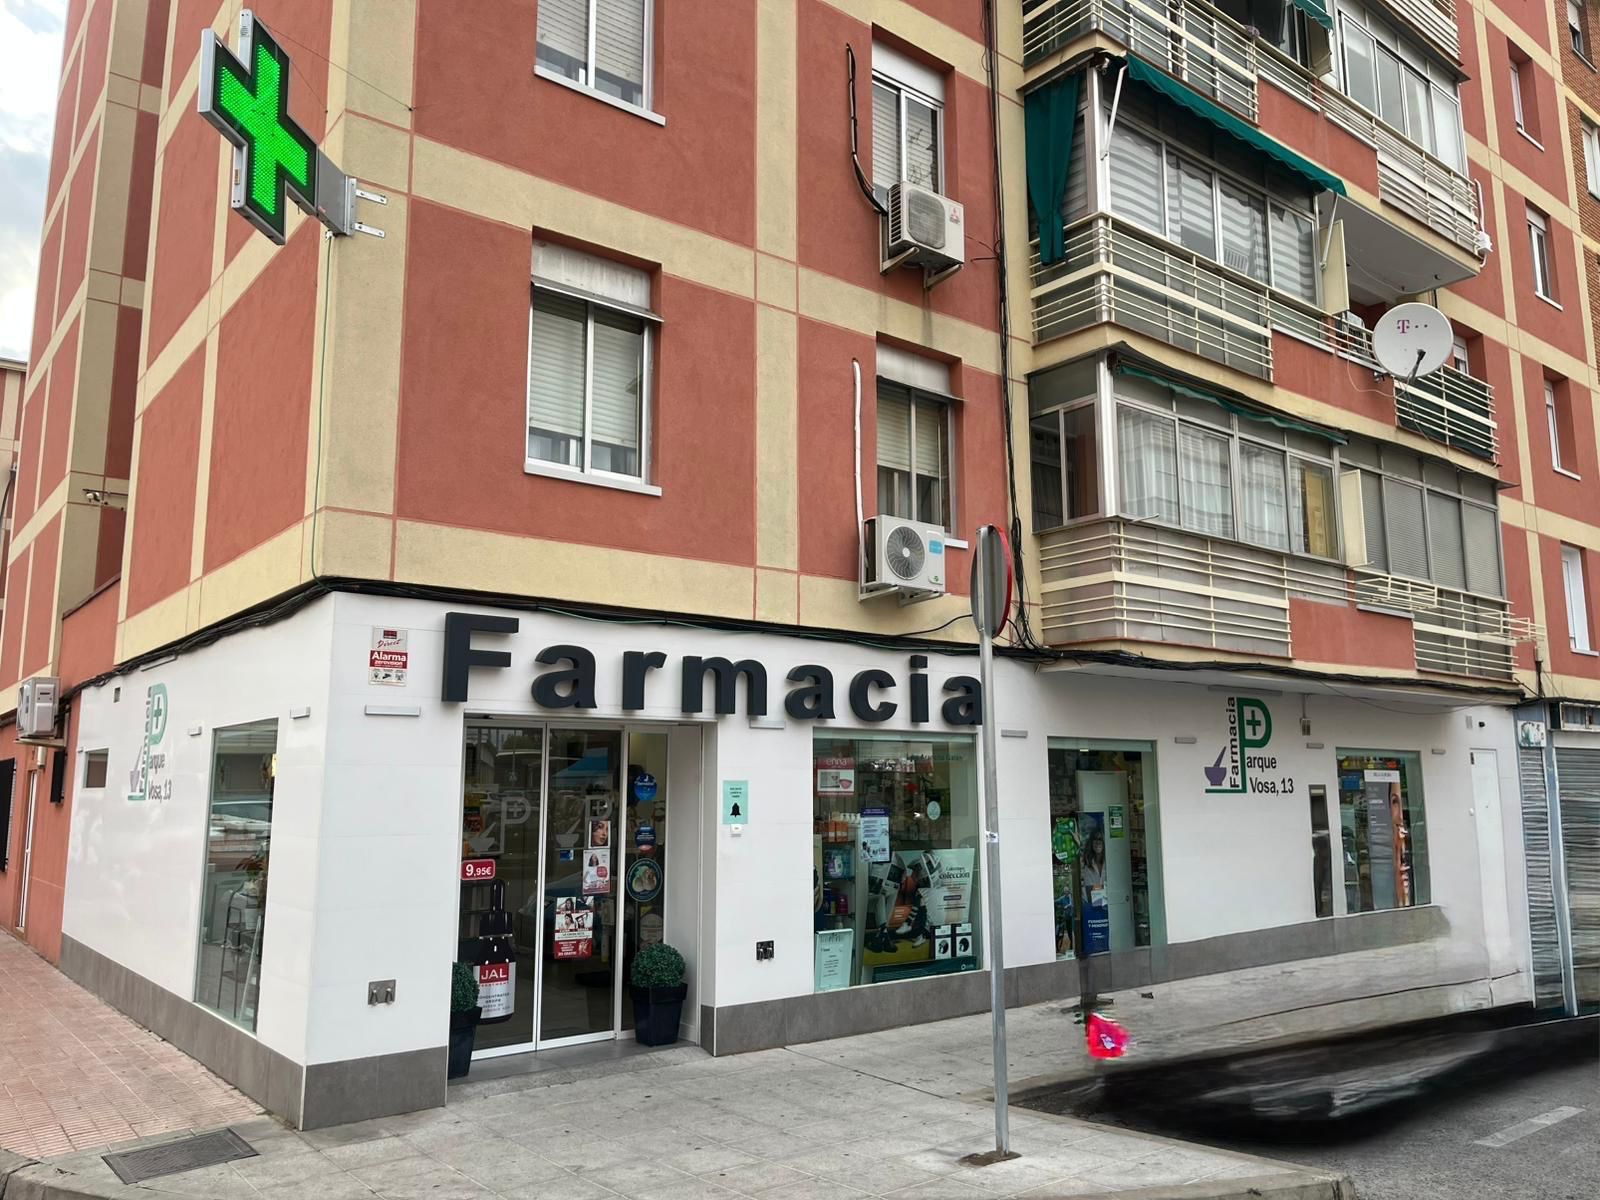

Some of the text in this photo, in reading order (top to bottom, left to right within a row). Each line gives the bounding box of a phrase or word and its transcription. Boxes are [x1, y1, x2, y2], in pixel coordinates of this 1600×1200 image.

[371, 651, 406, 662] Alarma
[441, 612, 983, 726] Farmacia
[1226, 696, 1240, 788] Farmacia
[163, 779, 172, 801] 13
[1249, 777, 1294, 796] Vosa, 13
